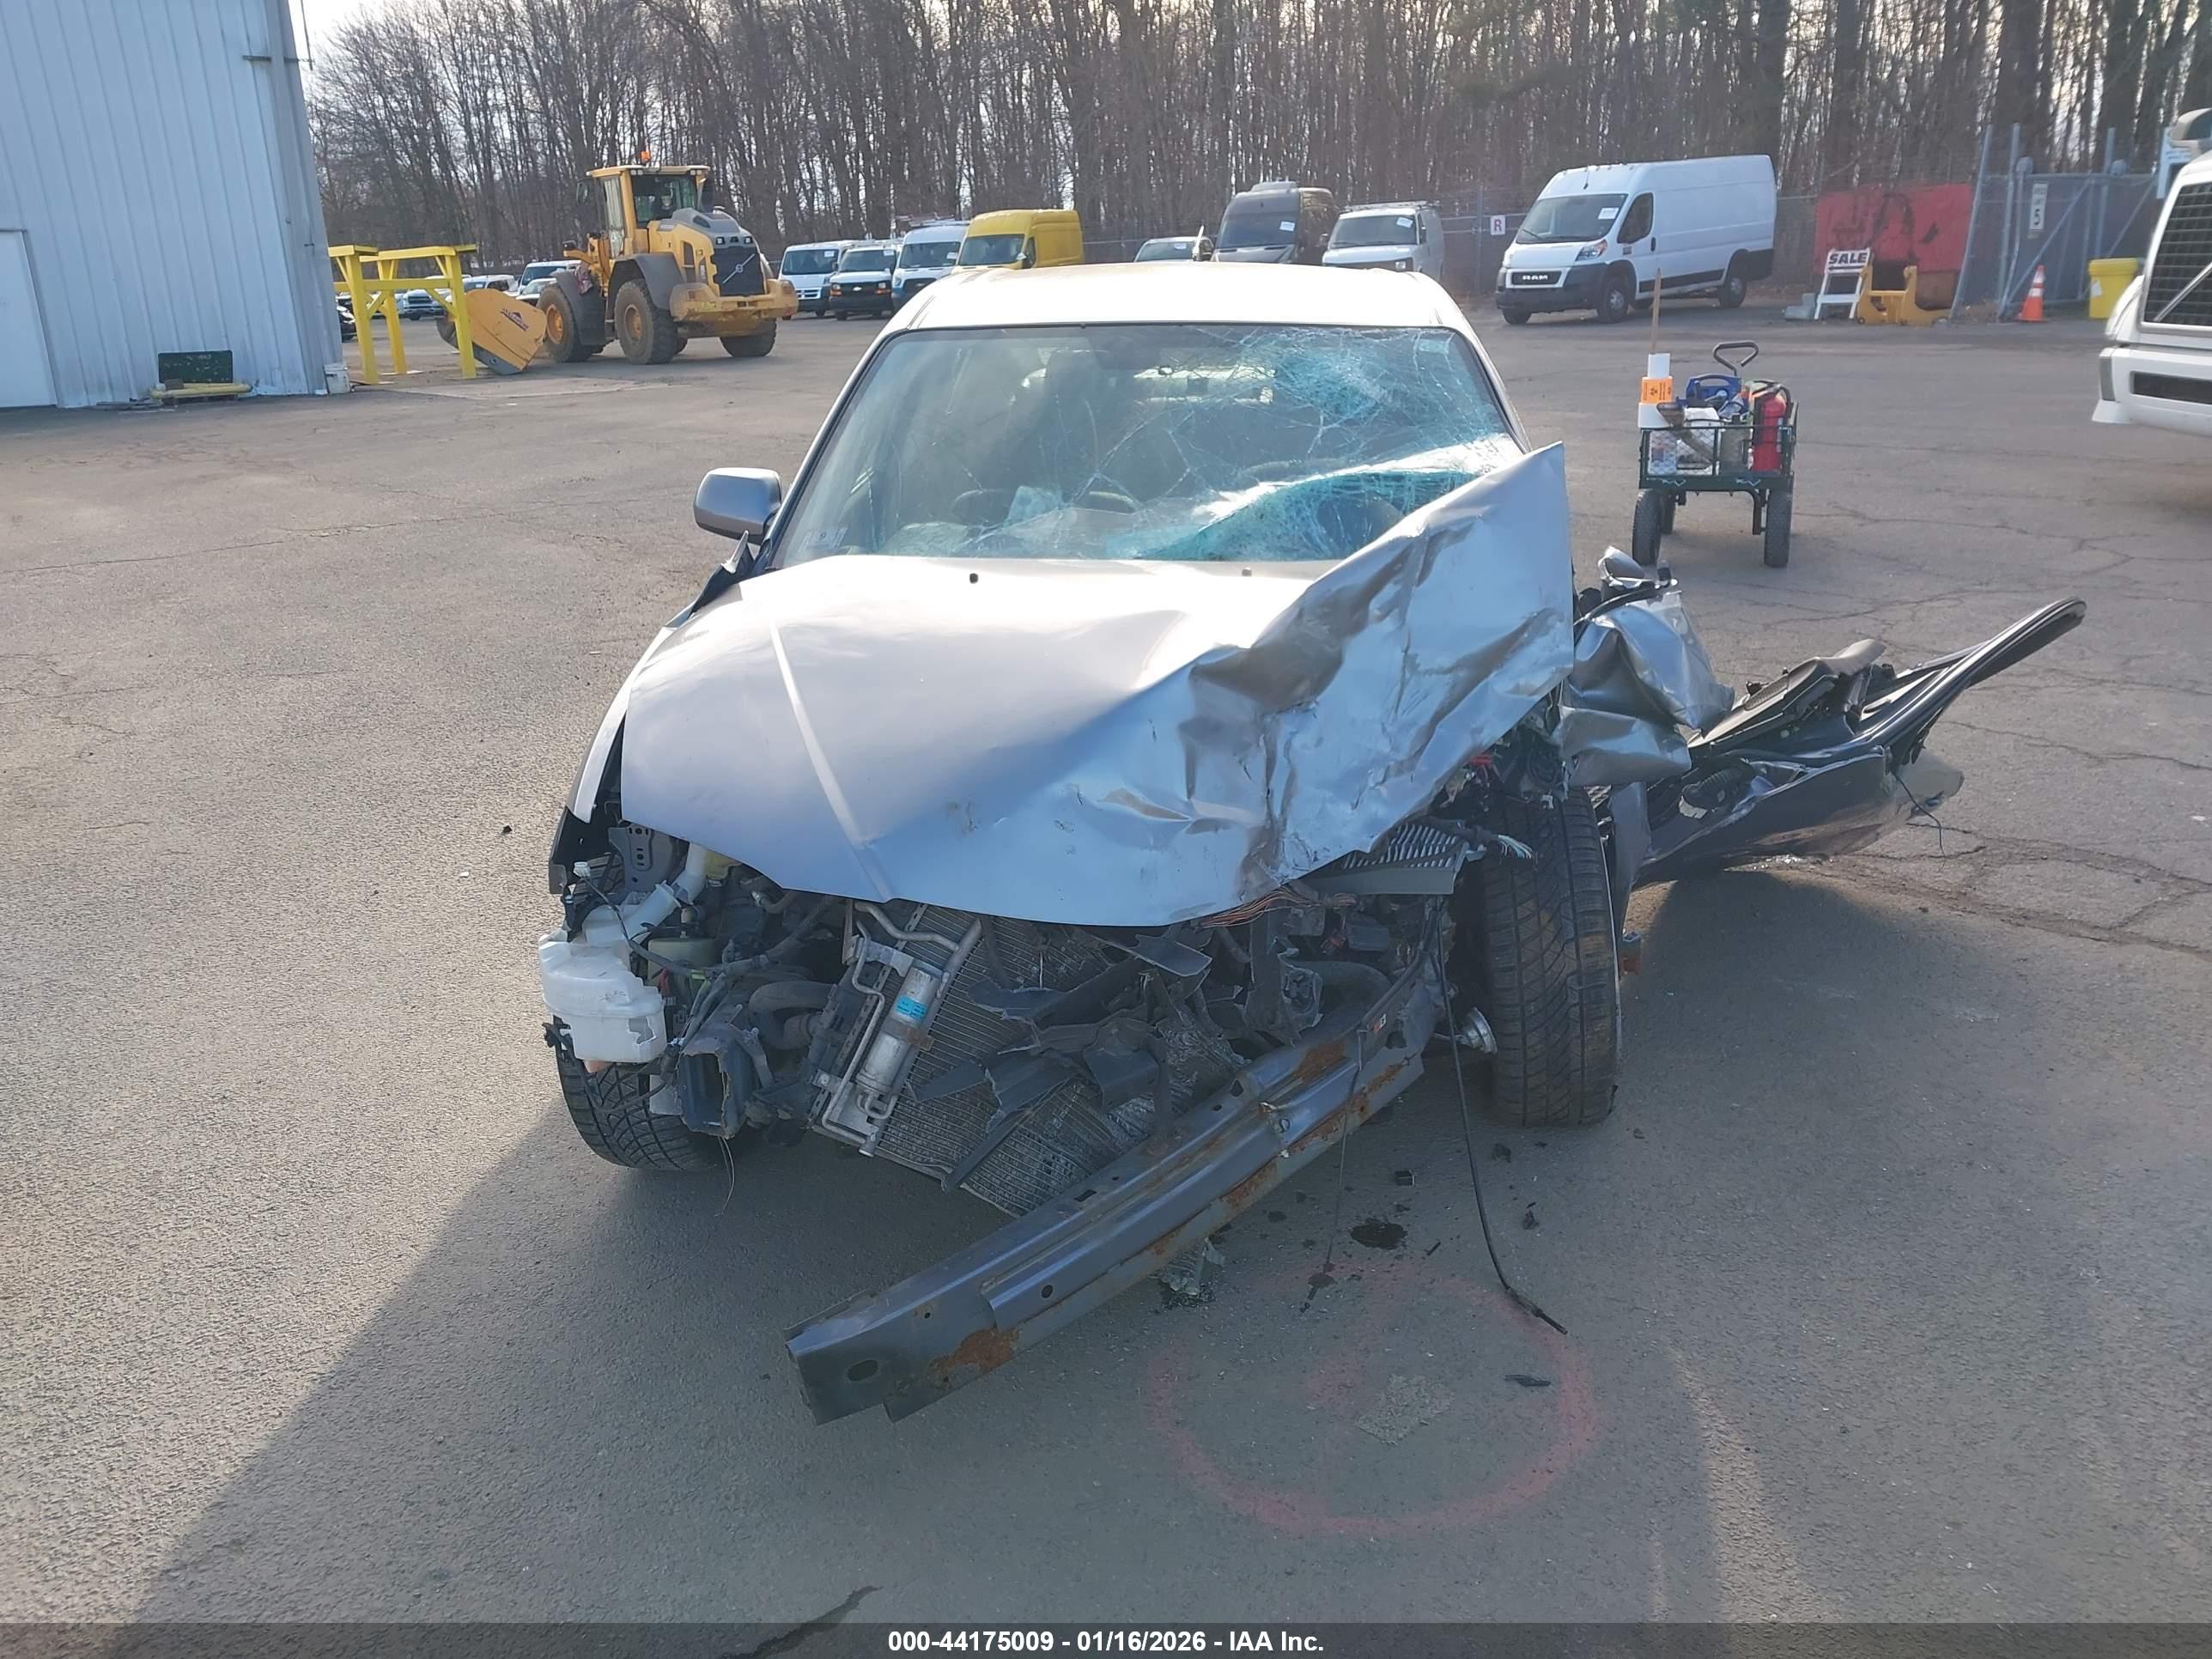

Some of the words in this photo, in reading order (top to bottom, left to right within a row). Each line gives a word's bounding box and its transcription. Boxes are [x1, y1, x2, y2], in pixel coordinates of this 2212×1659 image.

[2034, 208, 2041, 226] 5
[1494, 219, 1502, 232] R
[1828, 252, 1868, 264] SALE
